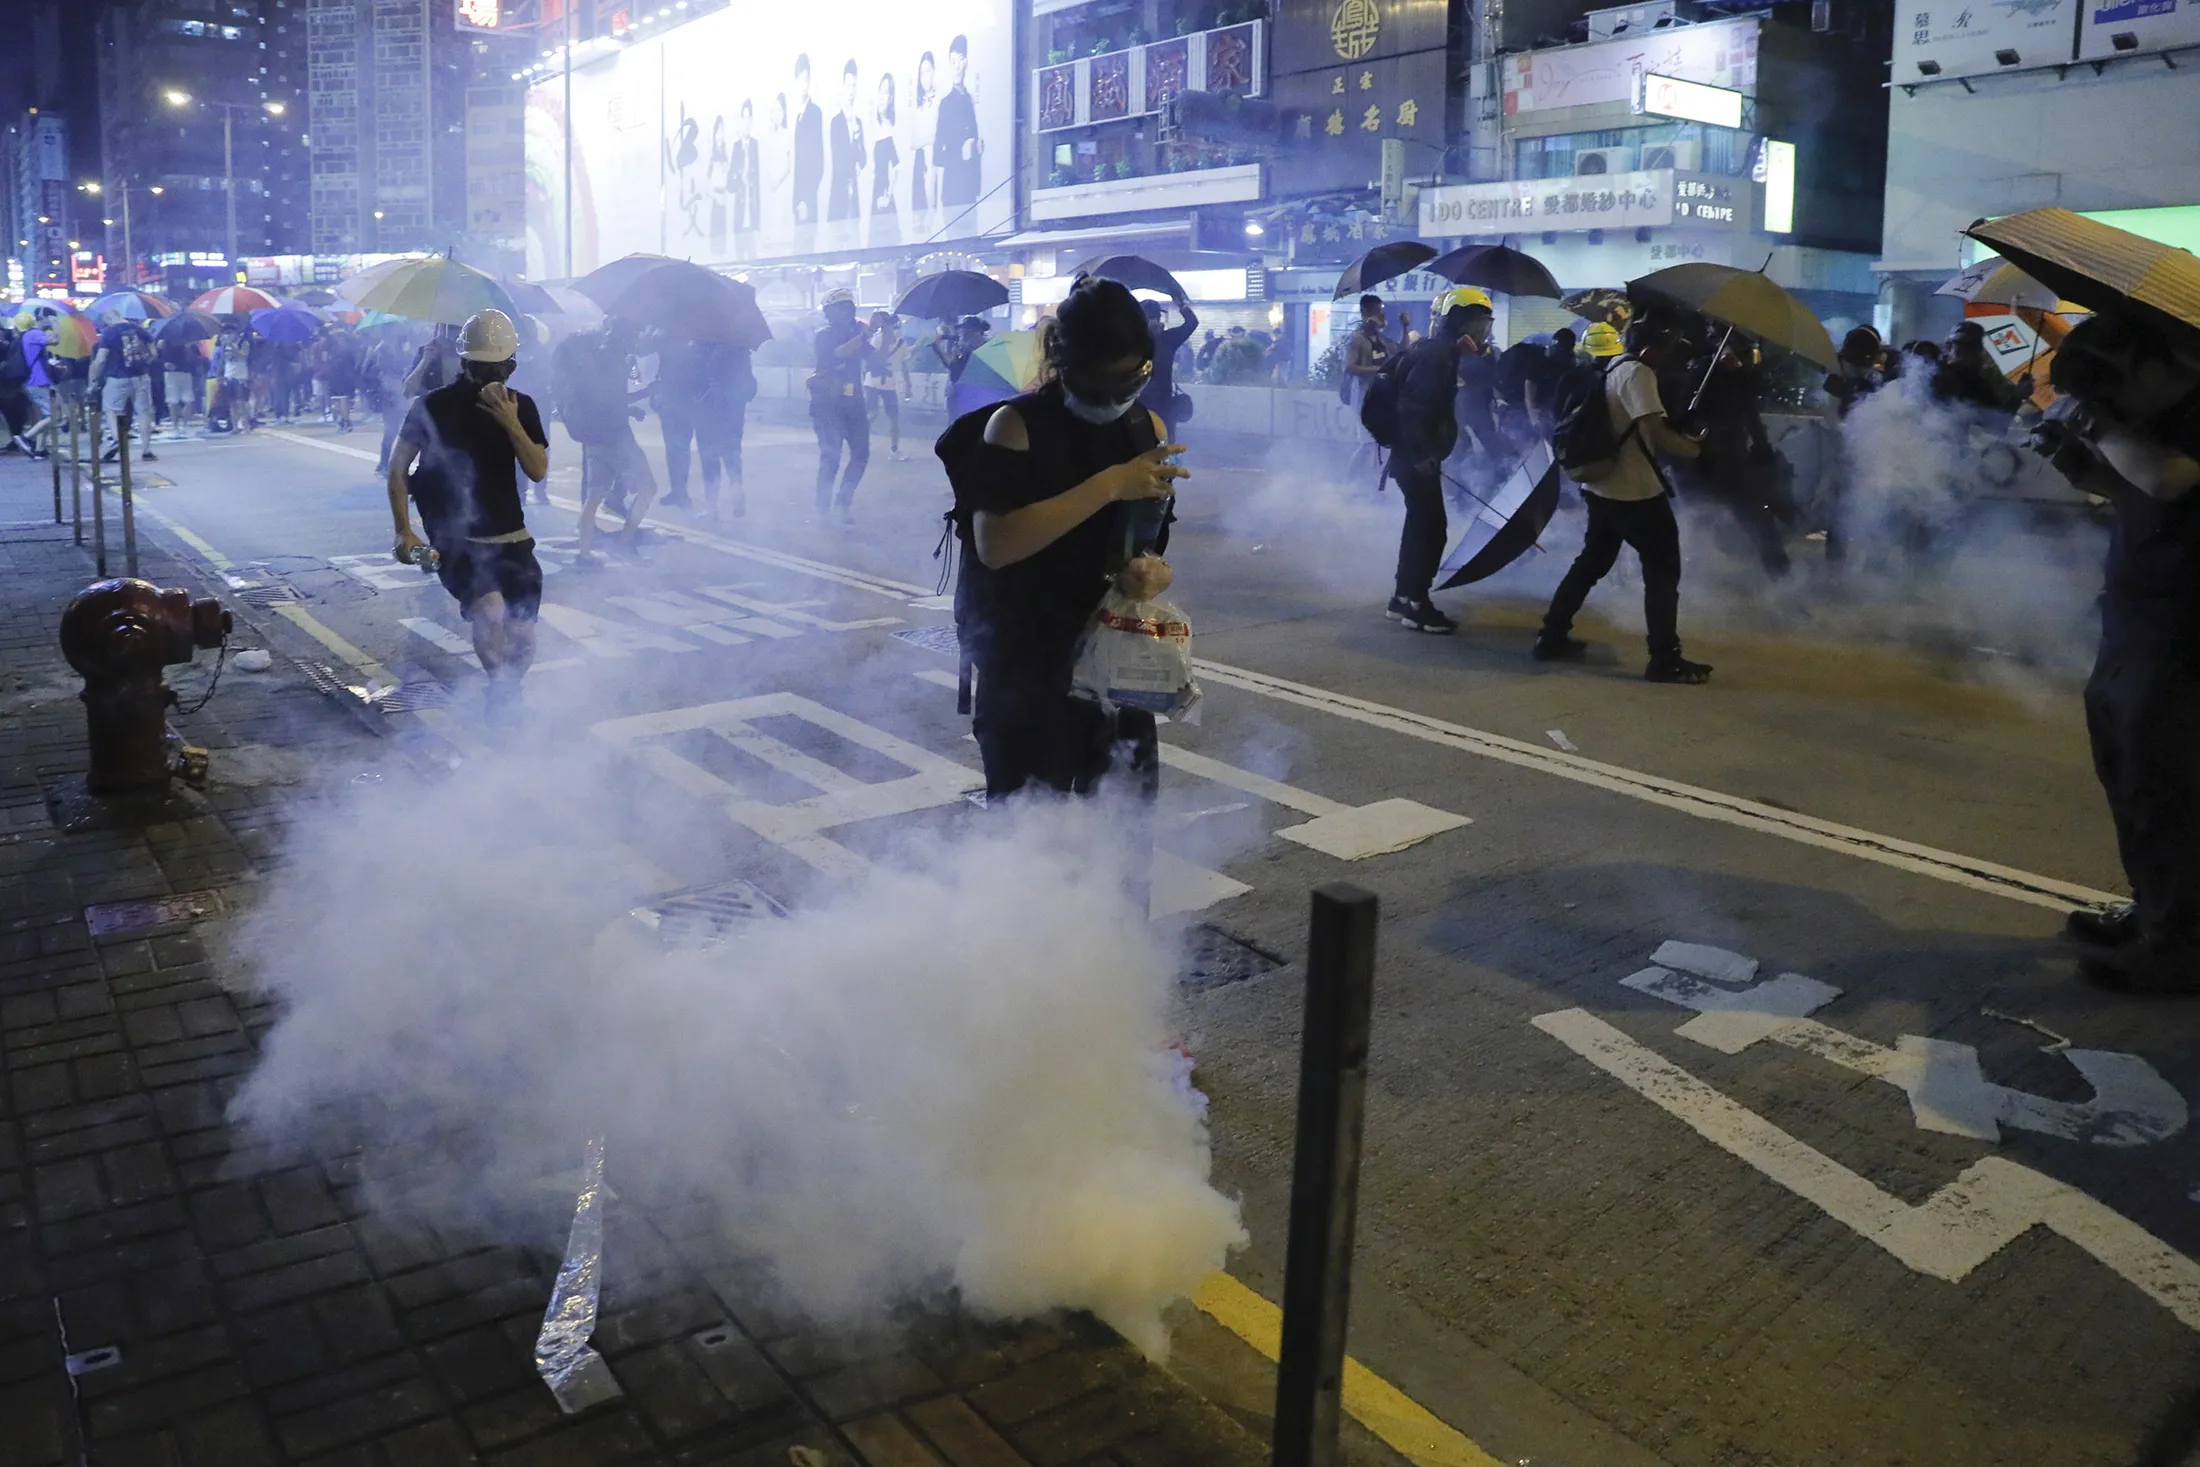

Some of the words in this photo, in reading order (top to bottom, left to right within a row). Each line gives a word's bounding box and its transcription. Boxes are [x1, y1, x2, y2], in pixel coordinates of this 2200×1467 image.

[1438, 201, 1461, 221] DO
[1467, 197, 1533, 220] CENTRE
[1544, 188, 1657, 216] 愛都婚紗中心
